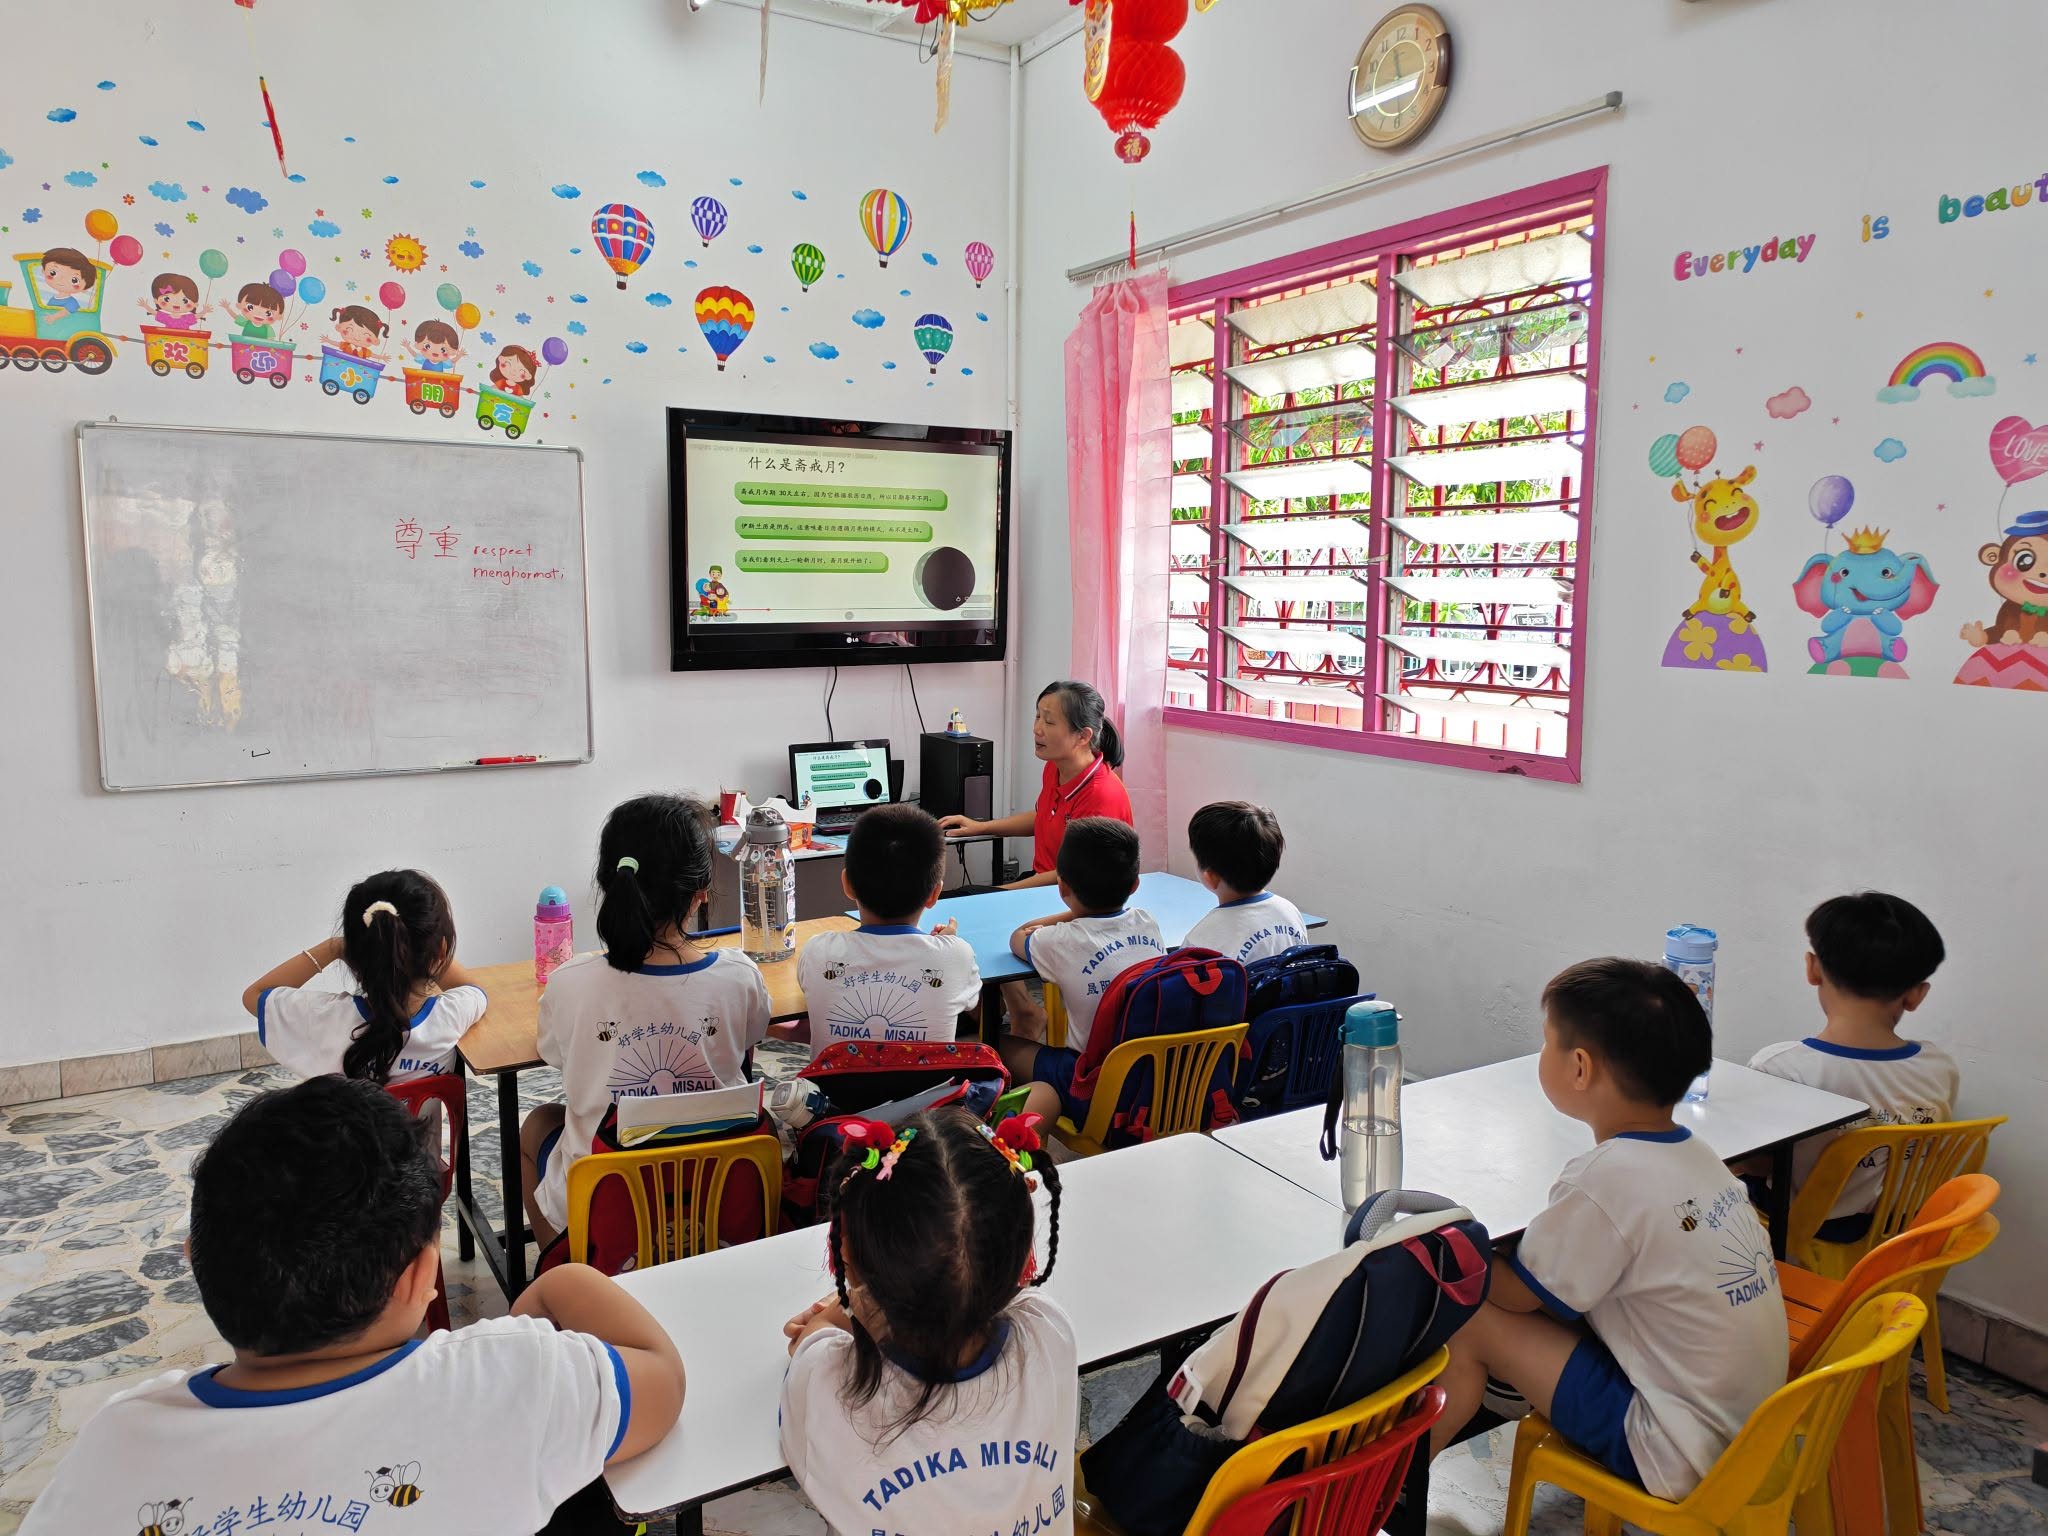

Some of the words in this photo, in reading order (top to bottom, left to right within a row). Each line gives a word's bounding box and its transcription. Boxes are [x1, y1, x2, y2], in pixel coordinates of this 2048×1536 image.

[1123, 137, 1142, 157] 福
[1673, 233, 1816, 281] Everyday
[1861, 214, 1889, 243] is
[1938, 173, 2048, 225] beaut
[163, 341, 190, 363] 欢
[250, 351, 278, 373] 迎
[339, 367, 363, 388] 小
[421, 382, 445, 403] 朋
[492, 402, 514, 424] 友
[2004, 434, 2048, 466] LOVE
[395, 518, 462, 560] 尊重
[473, 544, 533, 564] respect
[1082, 940, 1124, 975] TADIKA
[1127, 935, 1165, 954] MISALI
[1237, 928, 1272, 963] TADIKA
[1274, 925, 1304, 943] MISA
[843, 970, 922, 993] 好学生幼儿园
[618, 1022, 702, 1049] 好学生幼儿园
[829, 1024, 871, 1039] TADIKA
[885, 1029, 927, 1041] MISALI
[399, 1058, 450, 1075] MISAL
[672, 1080, 716, 1094] MISALI
[1725, 1276, 1768, 1307] TADIKA
[862, 1447, 968, 1512] TADIKA
[980, 1440, 1058, 1473] MISALI
